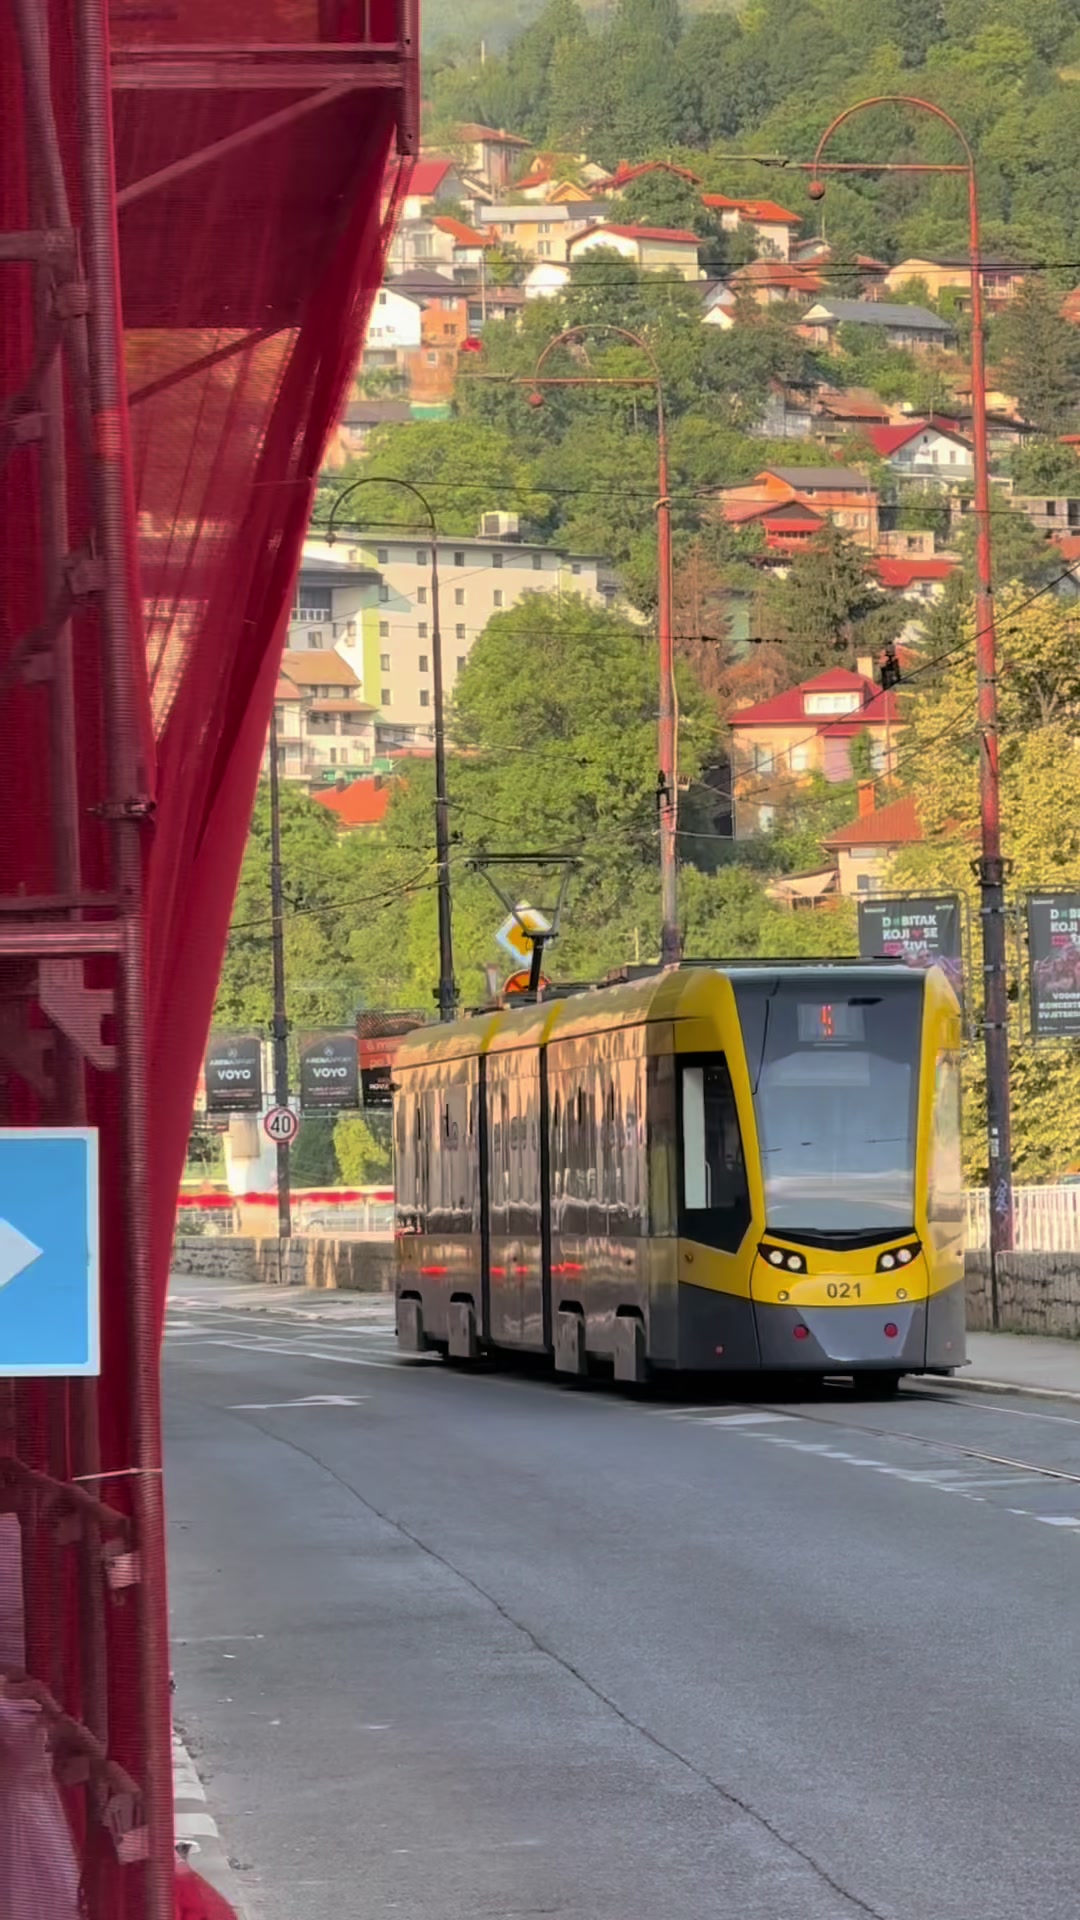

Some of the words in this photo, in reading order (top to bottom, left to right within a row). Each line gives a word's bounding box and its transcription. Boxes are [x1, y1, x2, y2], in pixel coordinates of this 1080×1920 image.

[883, 928, 910, 940] KOJI
[217, 1069, 251, 1080] VOYO
[313, 1067, 348, 1078] VOYO
[270, 1115, 291, 1134] 40
[827, 1282, 861, 1299] 021
